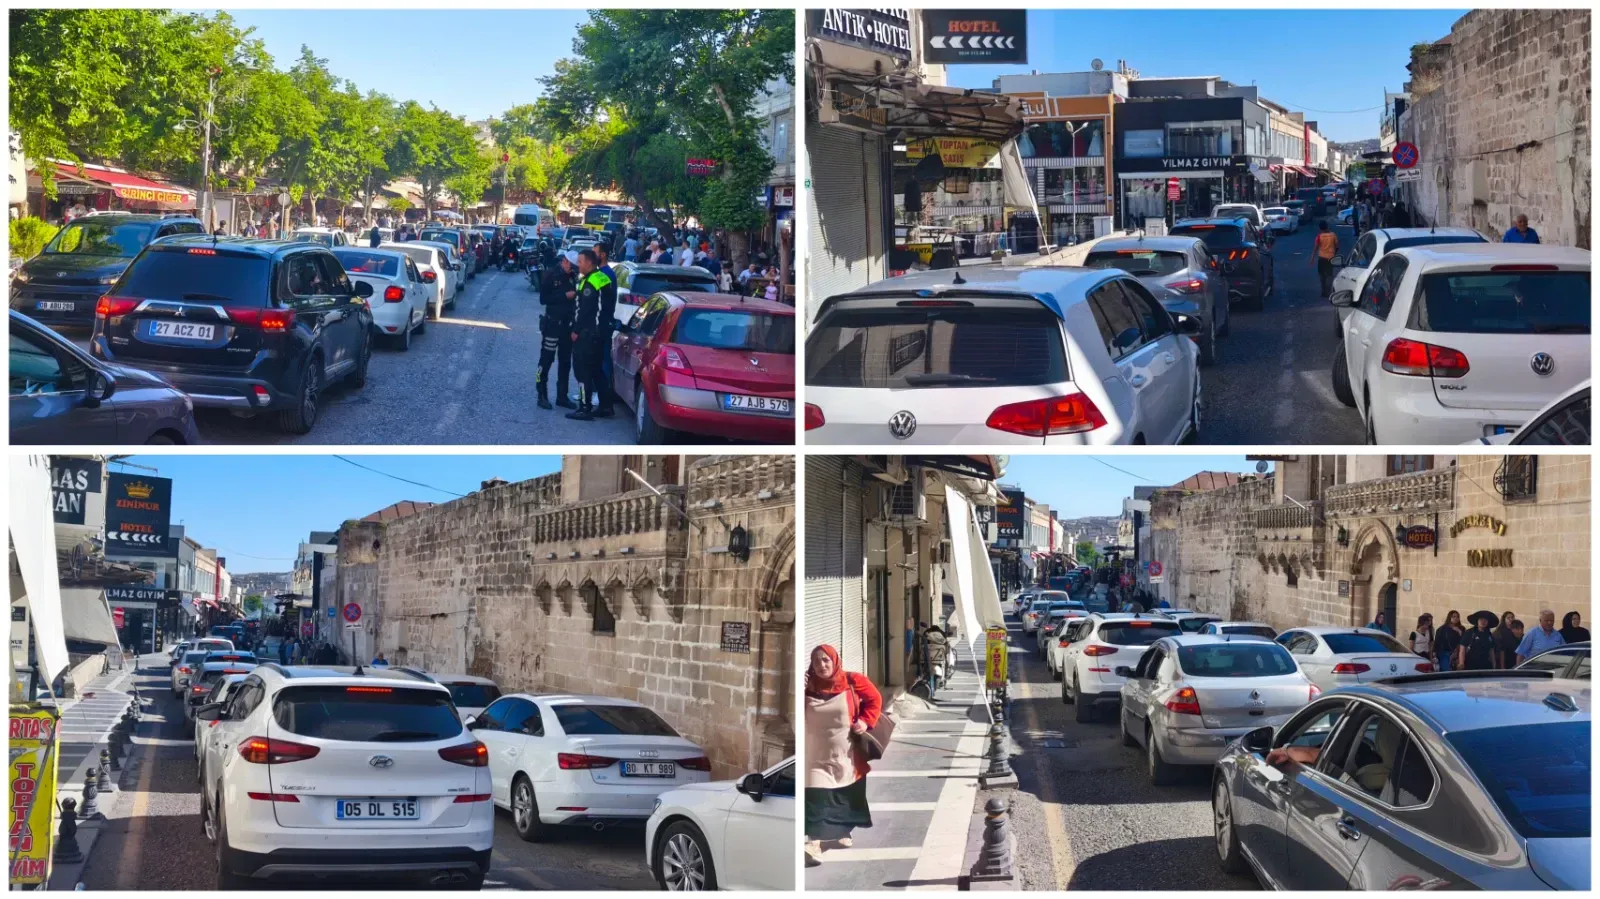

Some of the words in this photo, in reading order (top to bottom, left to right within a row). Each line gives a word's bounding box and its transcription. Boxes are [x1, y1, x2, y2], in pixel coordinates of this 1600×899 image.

[947, 20, 1000, 31] HOTEL
[873, 20, 912, 51] HOTEL
[939, 141, 968, 150] TOPTAN
[1162, 158, 1200, 168] YILMAZ
[156, 323, 168, 334] 27
[173, 325, 193, 337] ACZ
[198, 327, 212, 338] 01
[731, 396, 743, 407] 27
[747, 398, 766, 409] AJB
[769, 399, 789, 411] 579
[120, 523, 153, 533] HOTEL
[1408, 533, 1434, 543] HOTEL
[1467, 549, 1513, 568] KONAK
[105, 589, 135, 599] LMAZ
[626, 763, 637, 773] 80
[643, 764, 654, 774] KT
[658, 764, 674, 774] 989
[10, 763, 36, 852] TOPTAN
[345, 803, 361, 816] 05
[368, 804, 386, 816] DL
[393, 804, 416, 816] 515
